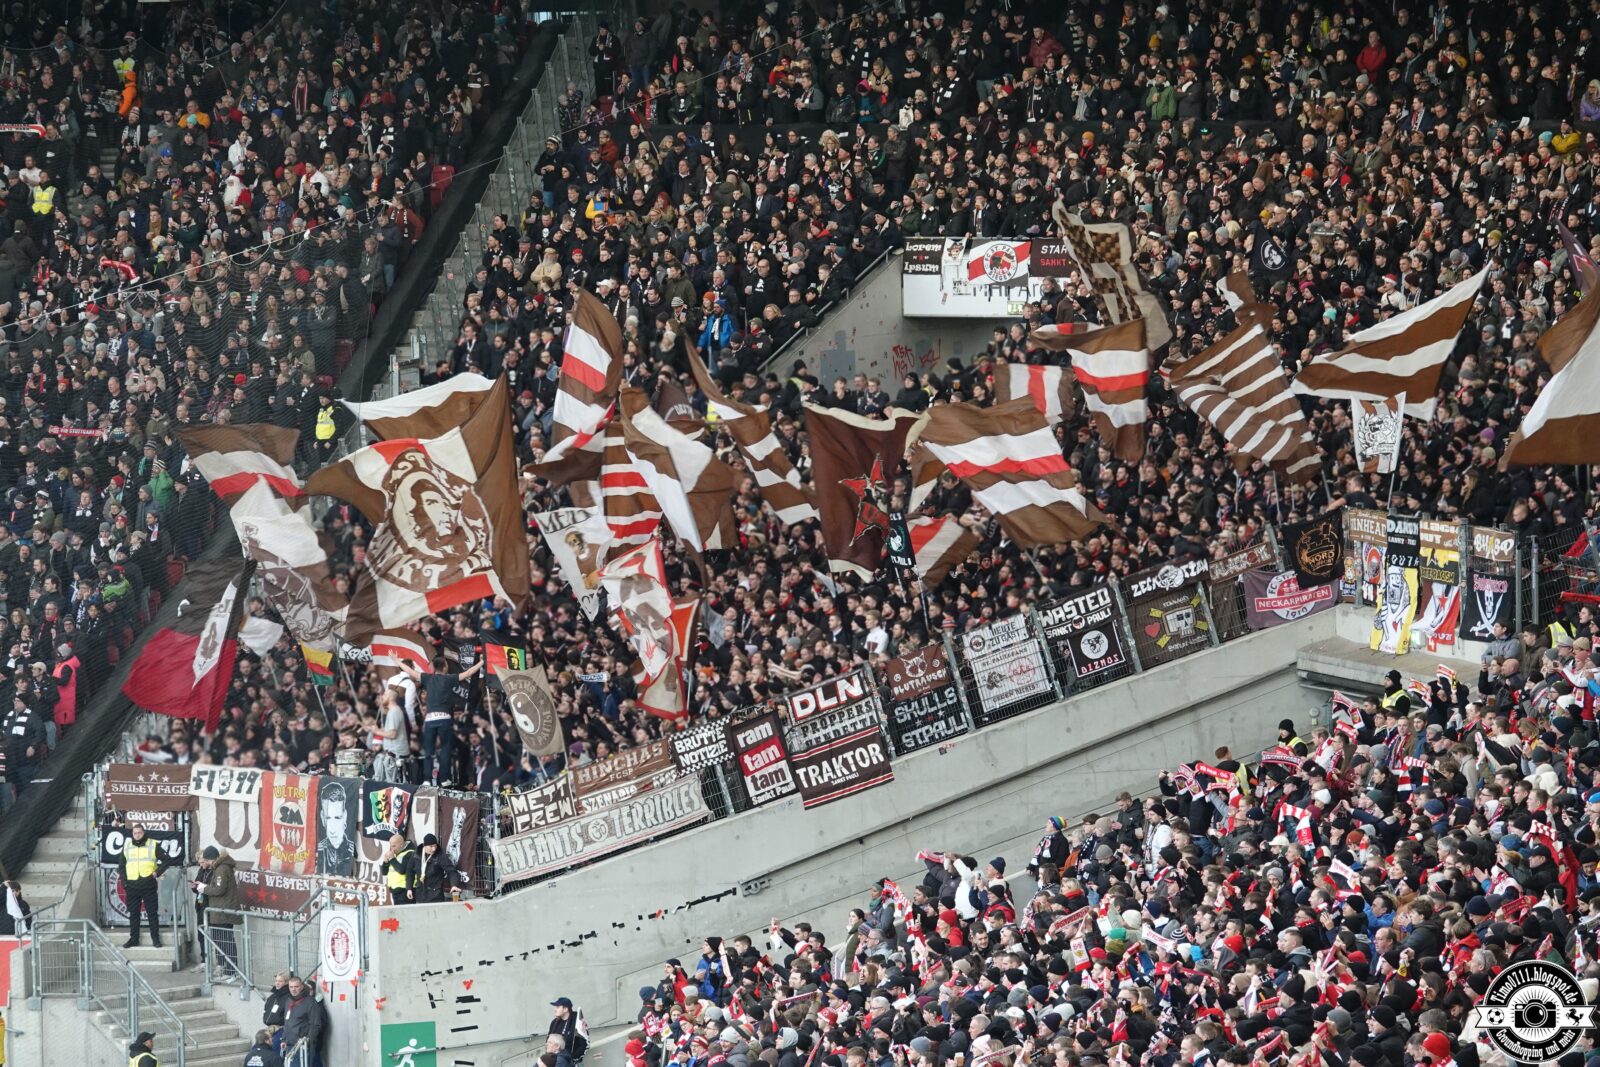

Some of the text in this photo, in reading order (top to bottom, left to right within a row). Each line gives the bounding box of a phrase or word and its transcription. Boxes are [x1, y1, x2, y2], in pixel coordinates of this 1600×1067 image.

[905, 241, 943, 252] Lorem
[904, 261, 940, 273] Ipsum
[1038, 587, 1112, 627] WASTED
[1258, 590, 1329, 608] NECKARPIRATEN
[1046, 608, 1112, 639] SANKT PAULI
[791, 675, 864, 721] DLN
[894, 687, 958, 724] SKULLS
[674, 726, 726, 753] BRUTTE
[736, 721, 773, 748] ram
[577, 743, 664, 784] HINCHAS
[679, 740, 728, 767] NOTIZIE
[743, 744, 781, 771] tam
[795, 743, 885, 789] TRAKTOR
[111, 784, 153, 794] SMILEY
[750, 767, 787, 792] tam
[515, 779, 568, 812] METT
[751, 789, 775, 806] Sankt
[515, 800, 573, 832] CREW
[608, 780, 702, 839] TERRIBLES
[498, 821, 584, 875] ENFANTS
[265, 874, 311, 892] WESTEN
